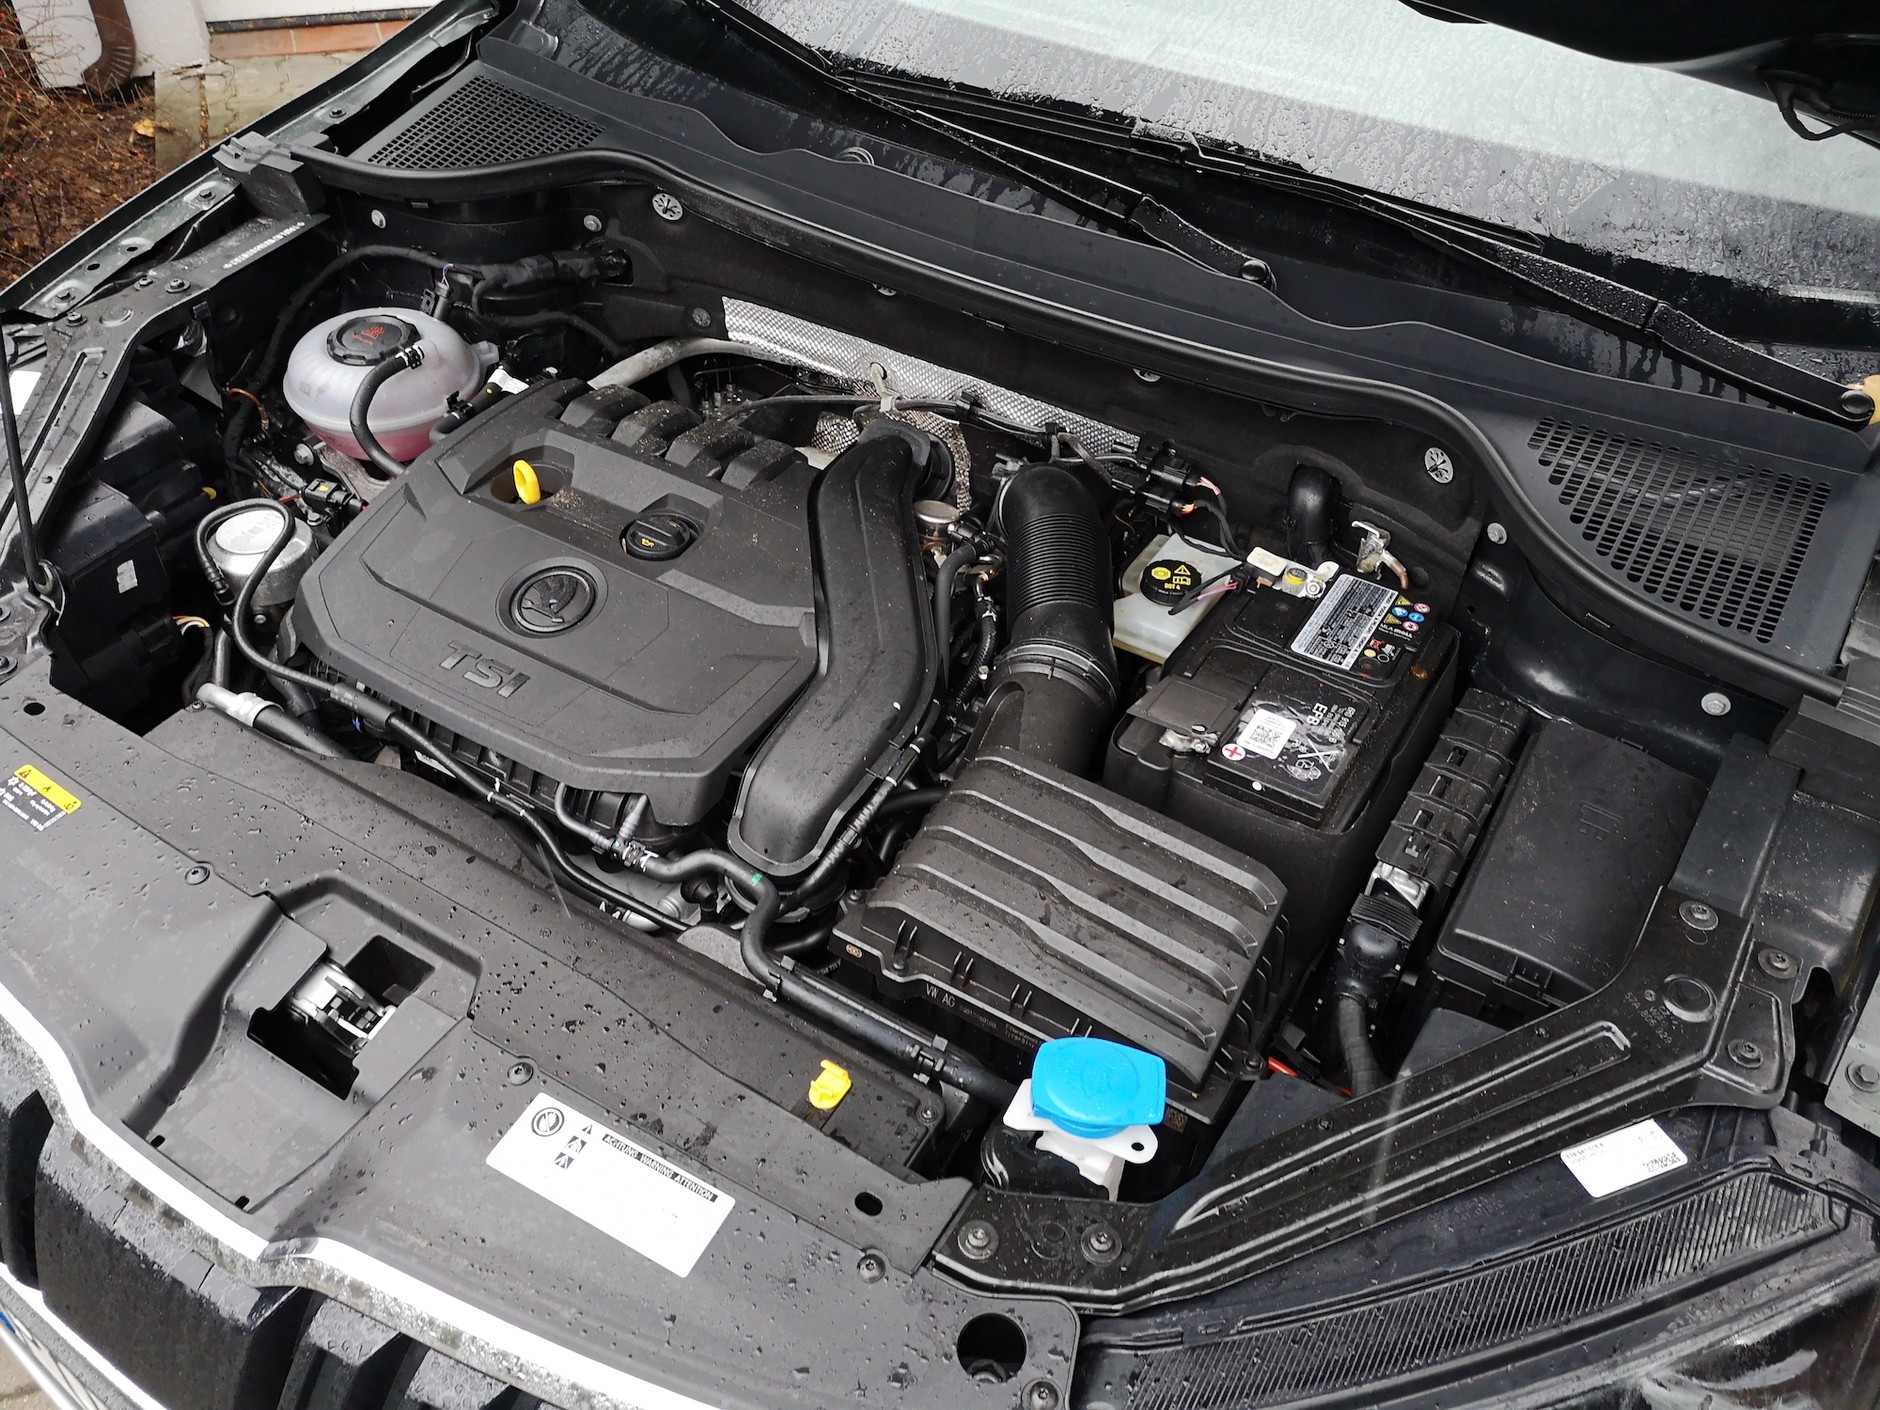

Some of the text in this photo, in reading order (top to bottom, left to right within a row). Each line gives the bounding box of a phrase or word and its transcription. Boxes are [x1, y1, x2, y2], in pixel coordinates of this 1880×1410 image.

[439, 640, 531, 699] TSI
[1307, 703, 1328, 726] EFB
[926, 983, 956, 1008] VW AG
[603, 1134, 714, 1201] ACHTUNG WARNING ATTENTION
